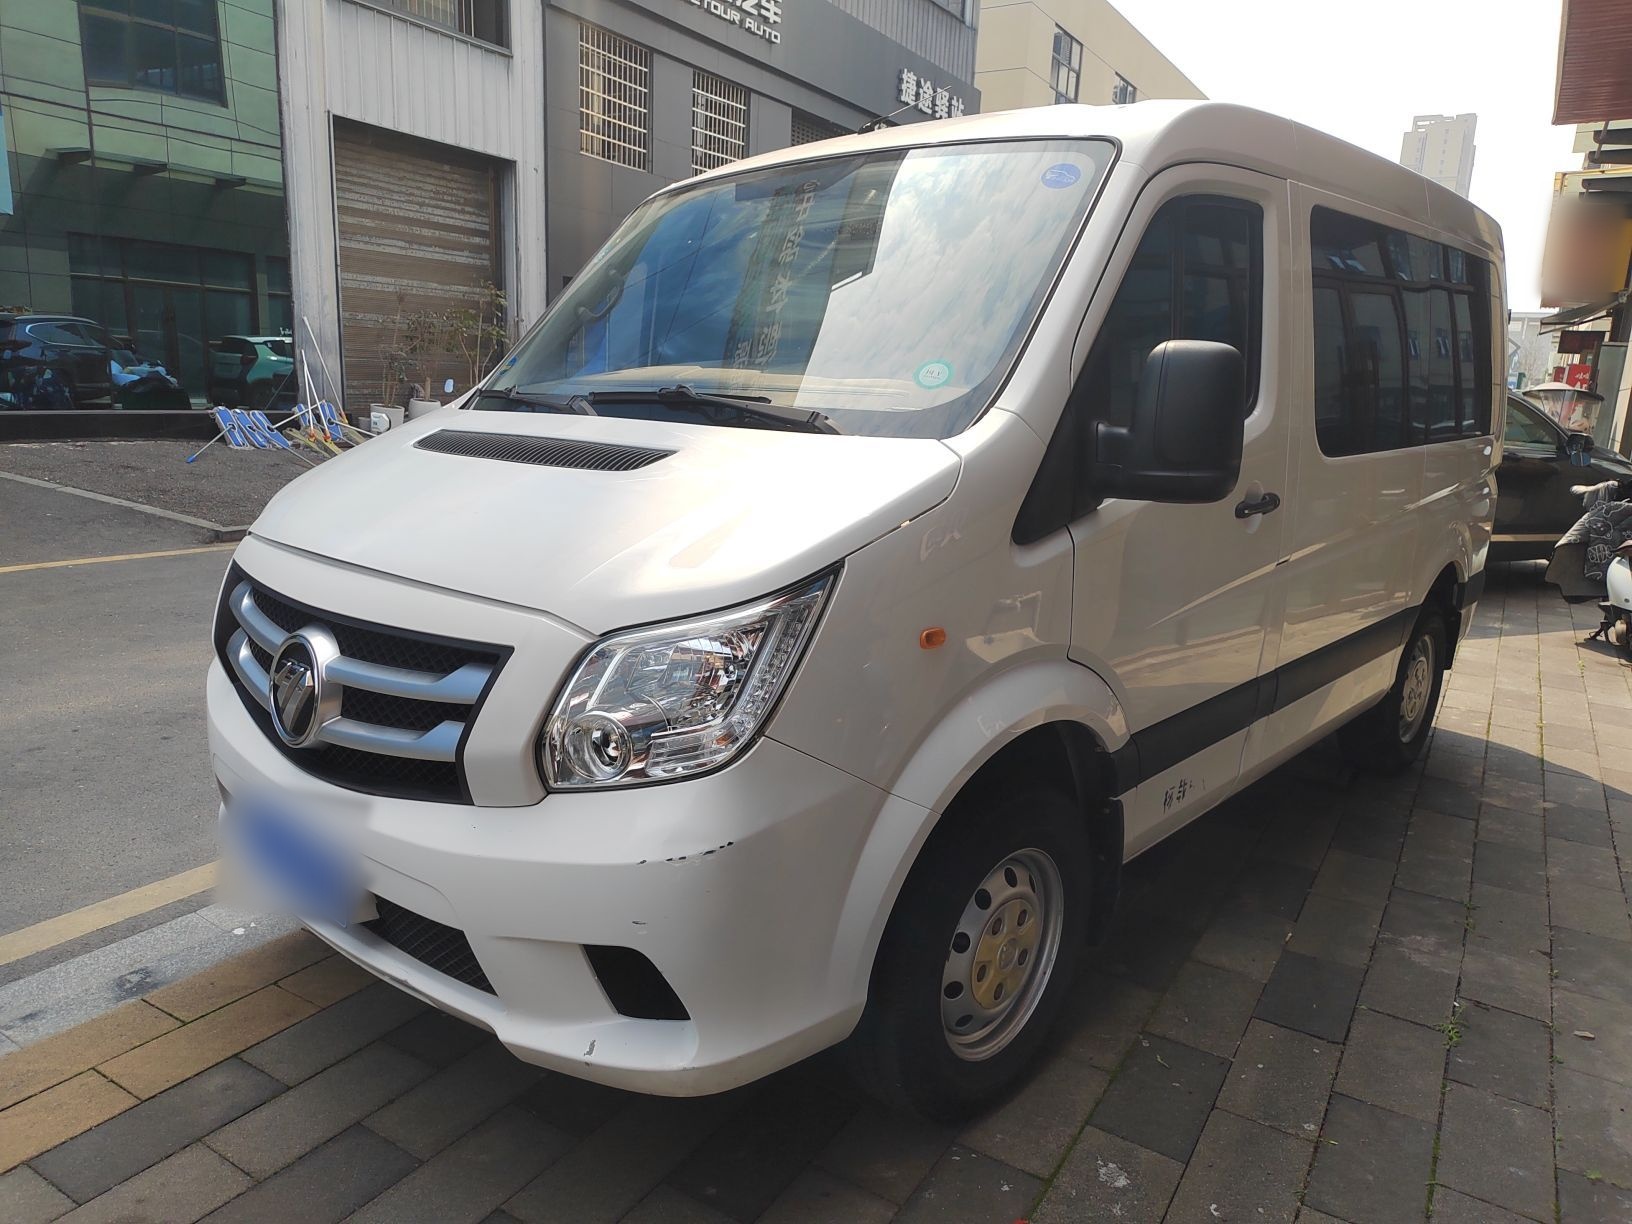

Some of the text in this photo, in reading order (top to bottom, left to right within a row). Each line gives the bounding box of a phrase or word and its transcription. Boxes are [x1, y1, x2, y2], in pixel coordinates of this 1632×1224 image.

[745, 17, 781, 44] AUTO
[901, 68, 964, 119] 捷途驿站
